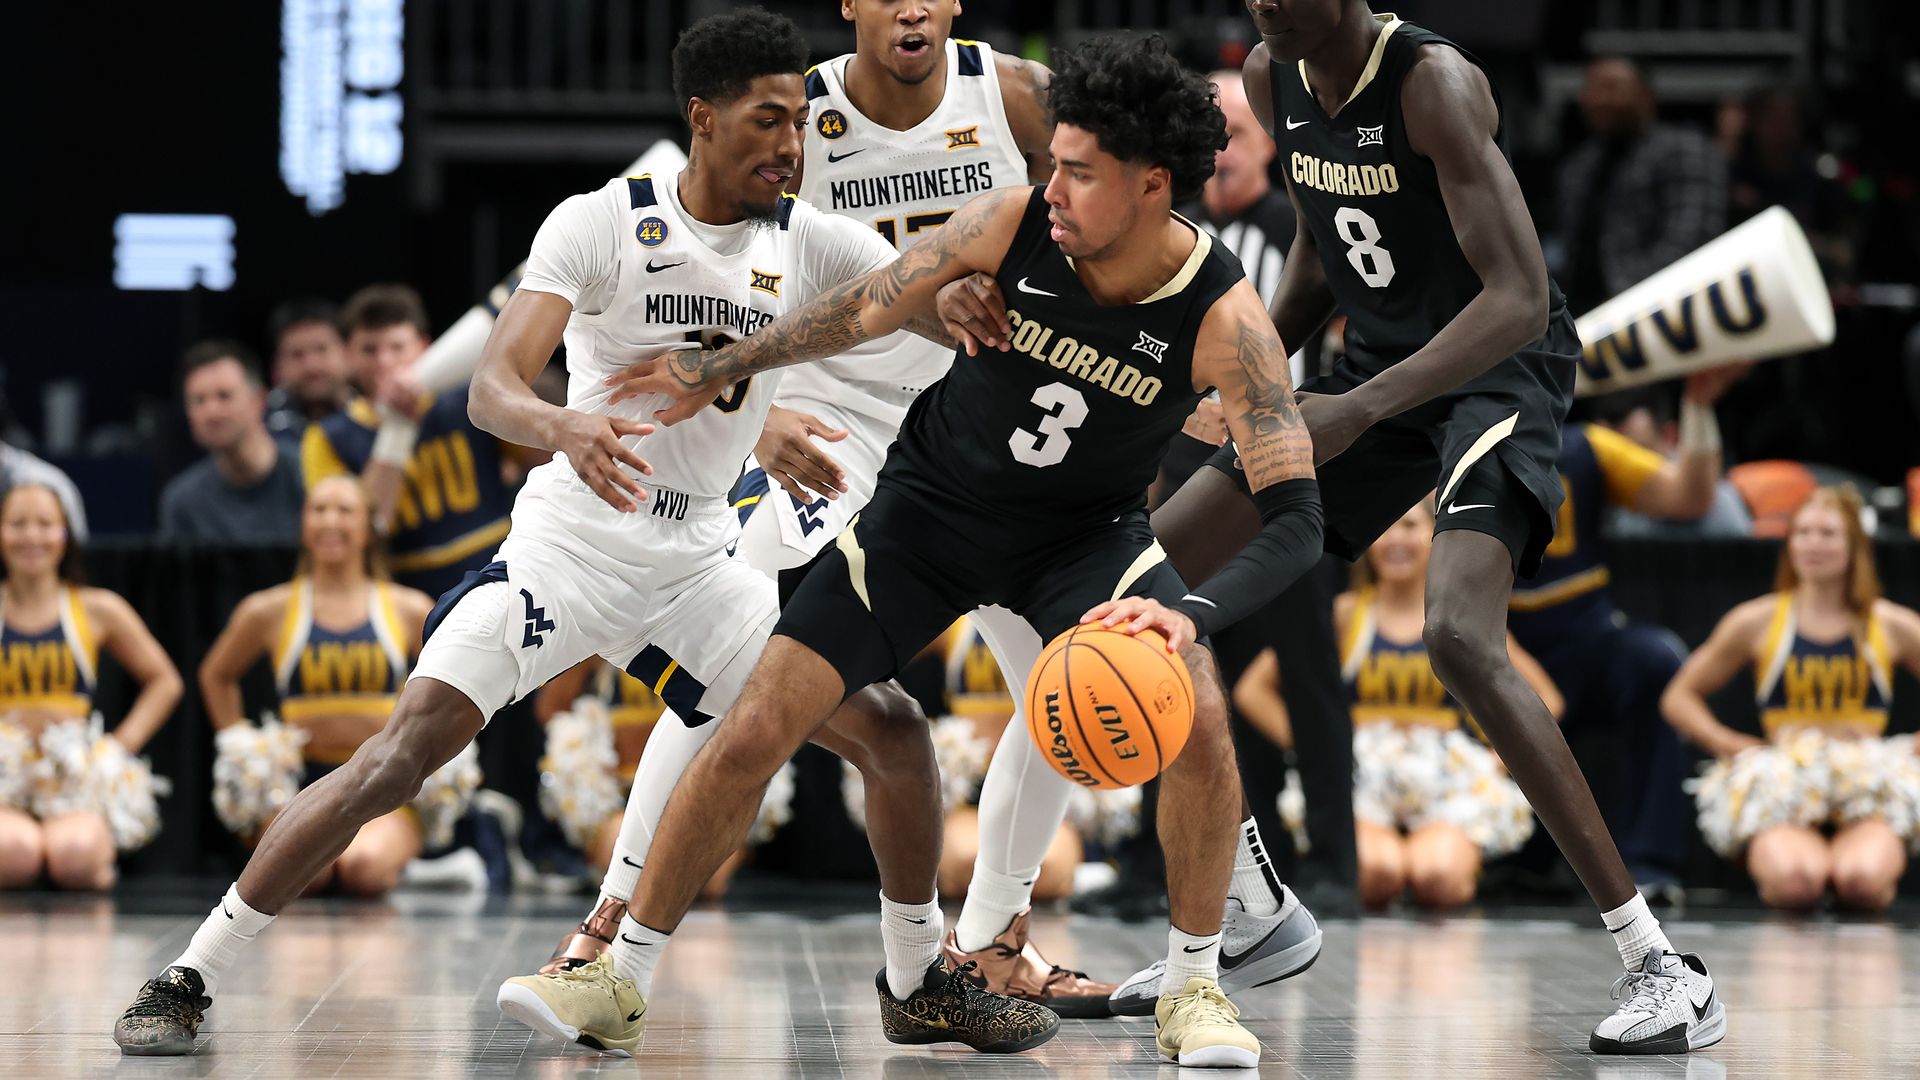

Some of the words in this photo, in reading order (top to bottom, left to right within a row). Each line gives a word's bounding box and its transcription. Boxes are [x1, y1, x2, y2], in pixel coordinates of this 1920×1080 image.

[822, 119, 843, 135] 44
[830, 161, 993, 209] MOUNTAINEERS
[1291, 151, 1399, 195] COLORADO
[640, 227, 662, 240] 44
[1334, 207, 1396, 288] 8
[1006, 309, 1163, 406] COLORADO
[1008, 382, 1090, 468] 3
[652, 489, 689, 520] WVU
[301, 641, 387, 696] WVU
[1045, 691, 1101, 787] Wilson
